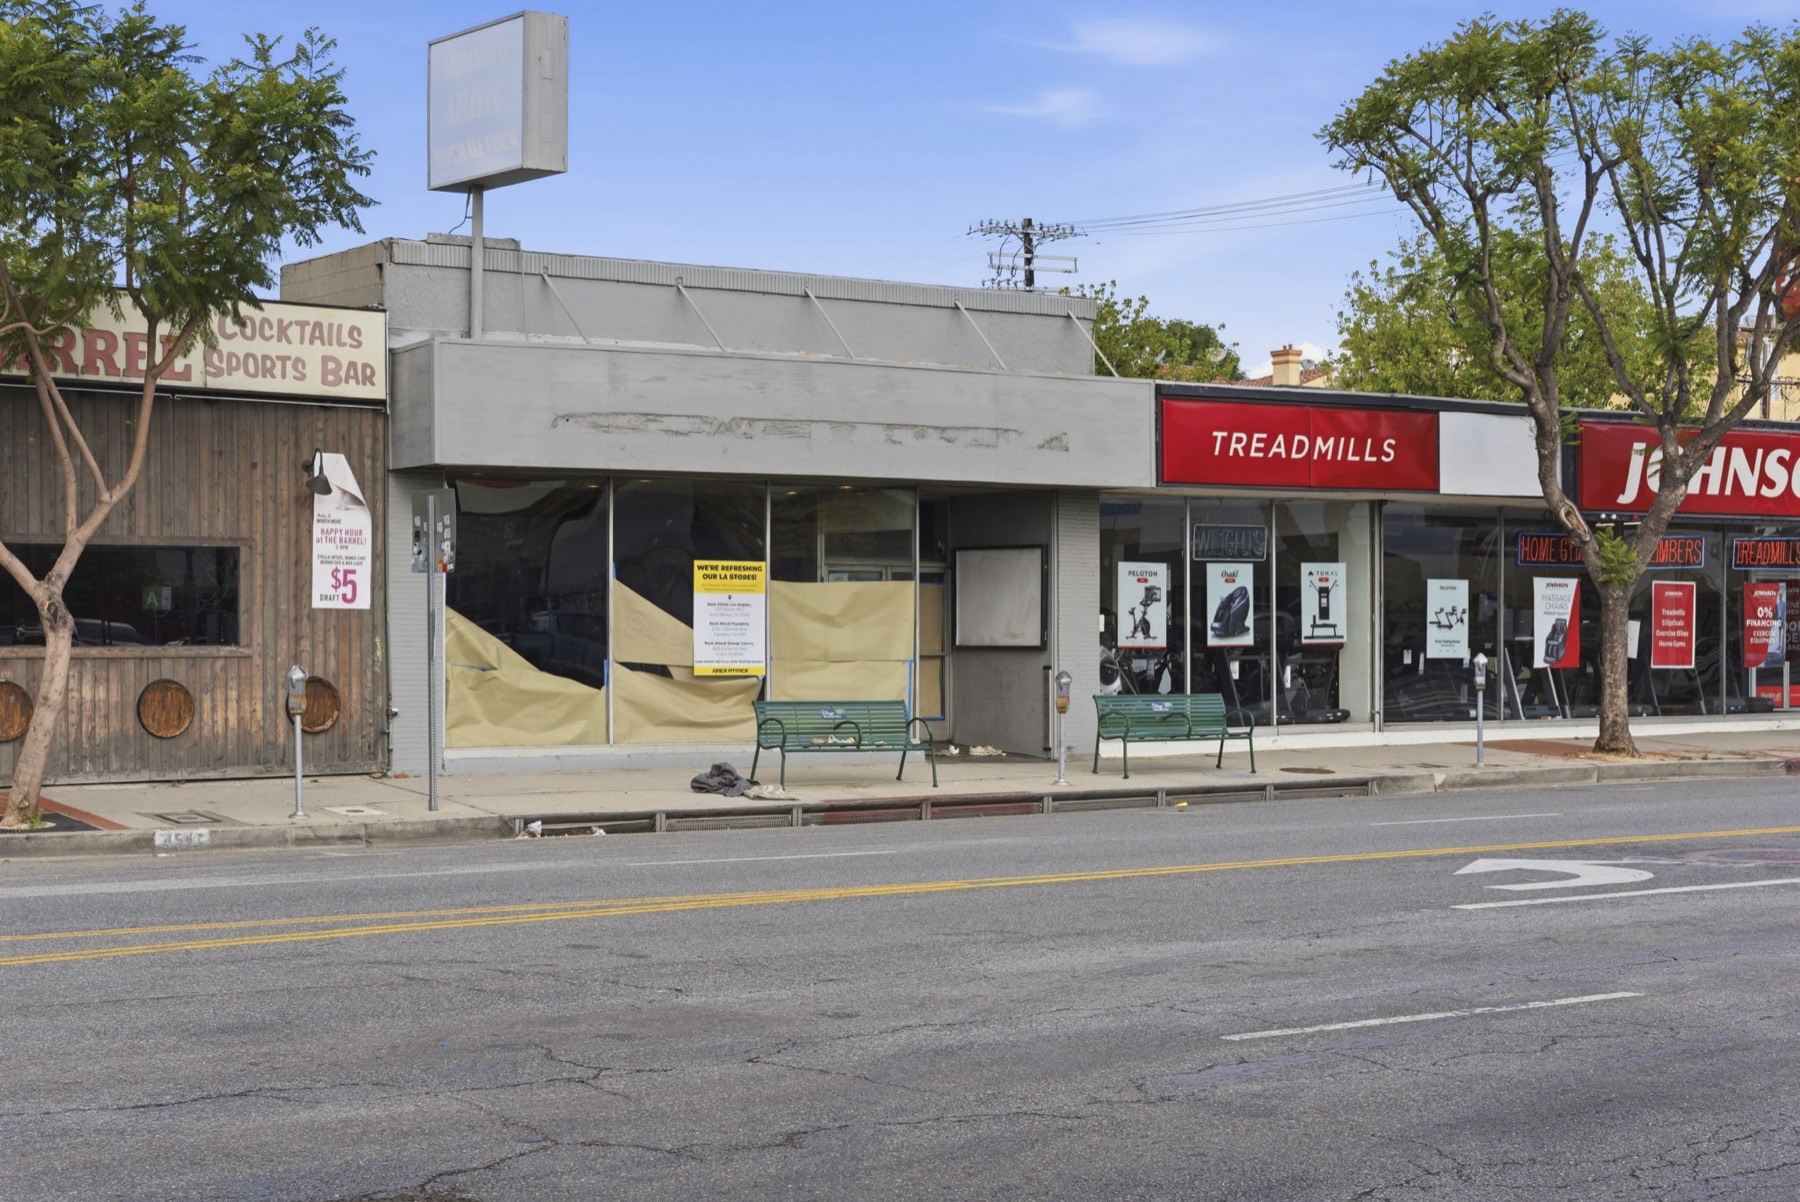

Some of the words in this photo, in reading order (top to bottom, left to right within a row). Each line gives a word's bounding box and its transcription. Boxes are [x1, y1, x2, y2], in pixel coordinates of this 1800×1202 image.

[217, 314, 363, 349] COCKTAILS
[0, 325, 192, 382] RREL
[206, 347, 307, 382] SPORTS
[321, 355, 376, 387] BAR
[1212, 431, 1396, 463] TREADMILLS
[320, 528, 343, 536] HAPPY
[344, 529, 363, 537] HOUR
[325, 536, 337, 544] THE
[339, 537, 366, 546] BARREL!
[1521, 536, 1556, 562] HOME
[720, 564, 763, 572] REFRESHING
[331, 565, 357, 604] $5
[320, 594, 339, 602] DRAFT
[1542, 594, 1571, 602] MASSAGE
[1545, 602, 1568, 610] CHAIRS
[1757, 606, 1773, 618] 0%
